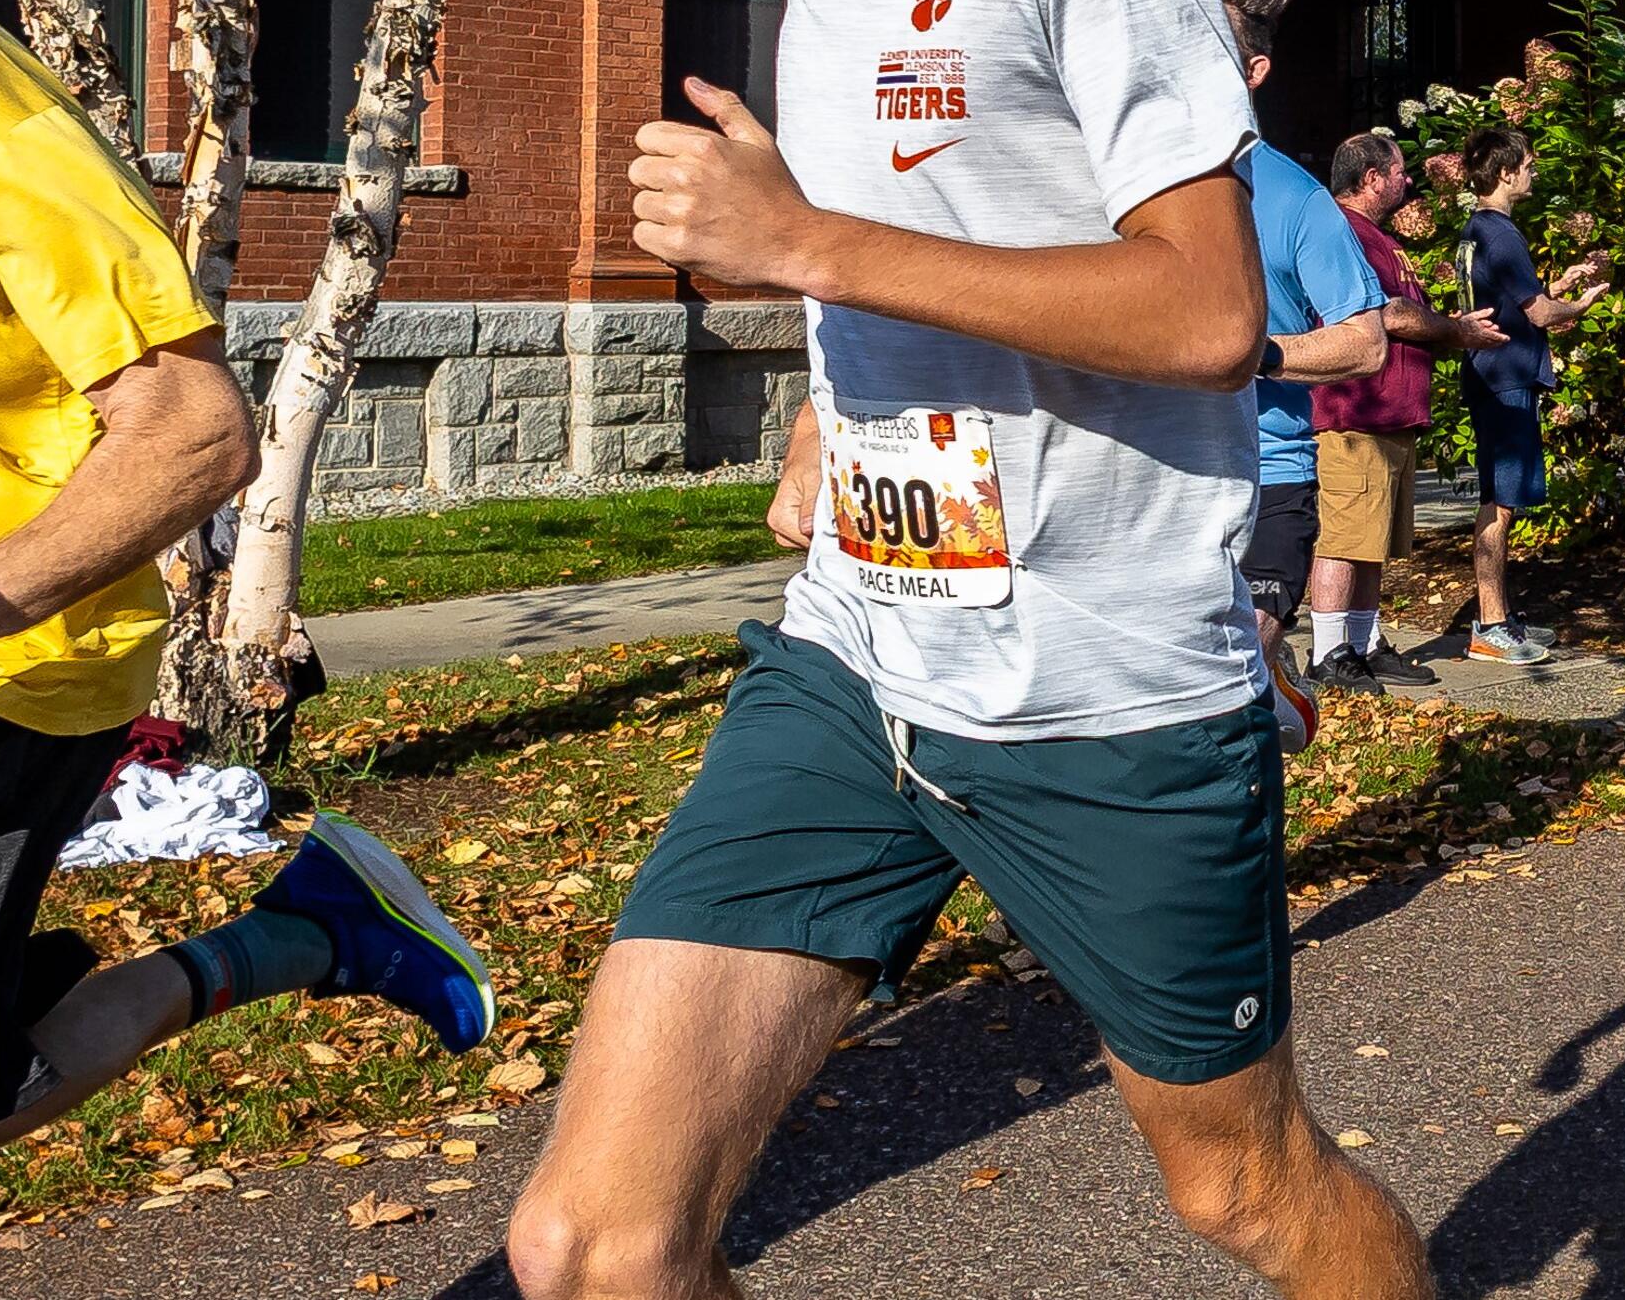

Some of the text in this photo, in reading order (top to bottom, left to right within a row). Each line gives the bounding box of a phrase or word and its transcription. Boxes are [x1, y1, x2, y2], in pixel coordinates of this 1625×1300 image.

[950, 61, 965, 72] SC
[875, 87, 966, 120] TIGERS
[872, 414, 920, 440] PEEPERS
[852, 473, 940, 549] 390
[858, 567, 958, 598] RACE MEAL
[1247, 580, 1281, 595] OKA
